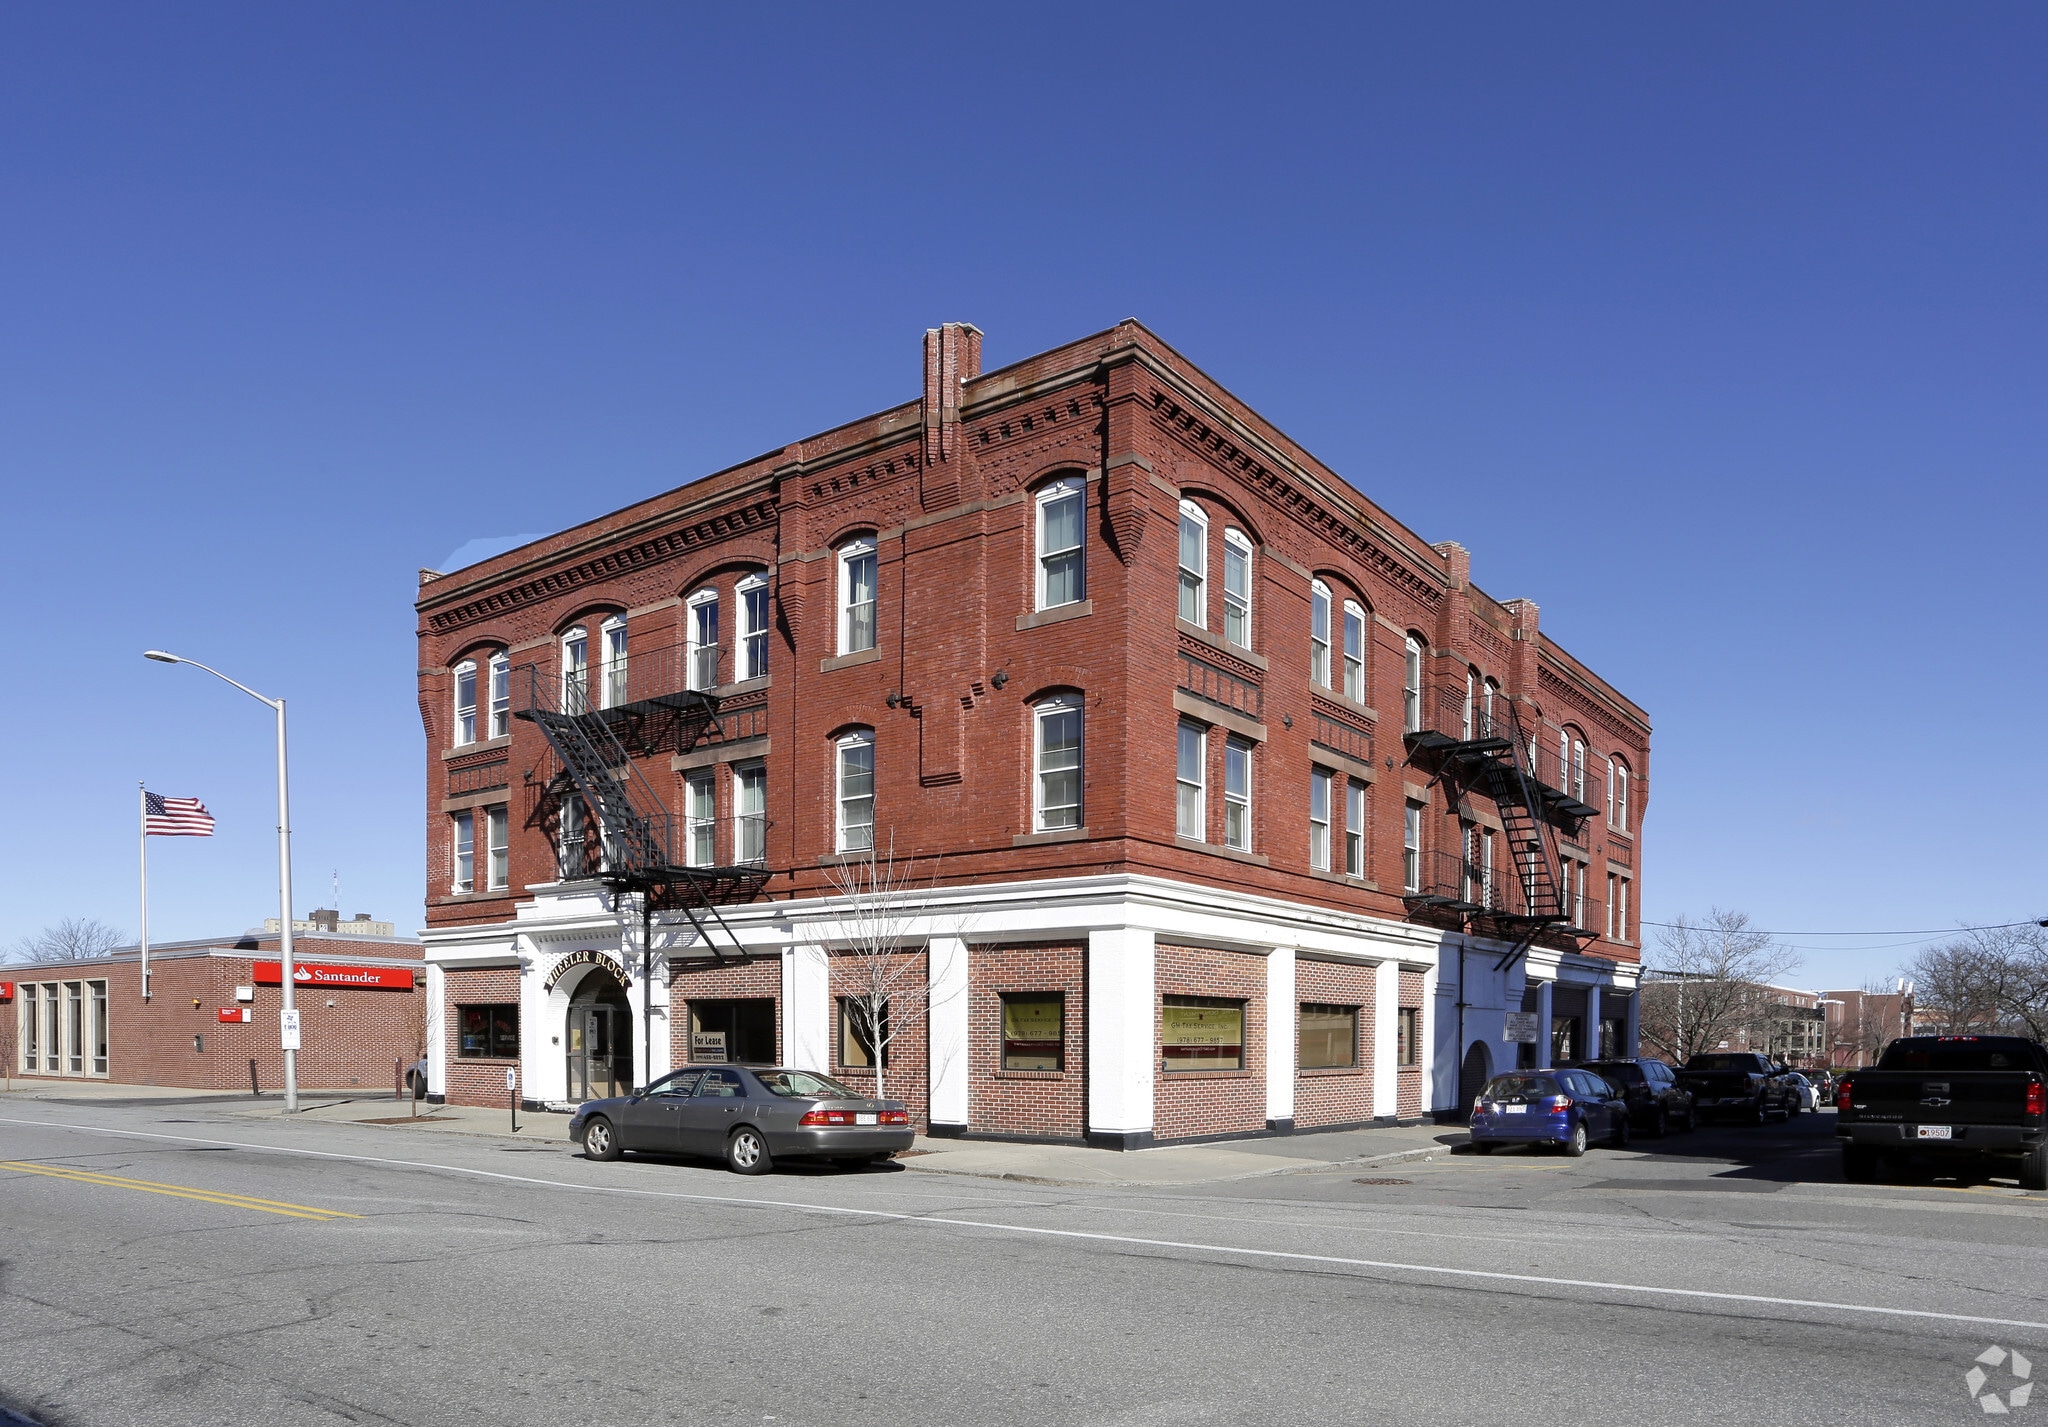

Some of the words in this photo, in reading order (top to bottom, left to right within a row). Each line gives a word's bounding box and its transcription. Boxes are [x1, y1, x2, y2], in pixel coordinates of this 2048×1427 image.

[546, 951, 589, 986] WHEELER
[595, 953, 628, 986] BLOCK
[314, 970, 381, 983] Santander
[694, 1035, 704, 1045] For
[705, 1035, 722, 1045] Lease
[1176, 1036, 1193, 1044] (978)
[1926, 1129, 1950, 1137] 19507
